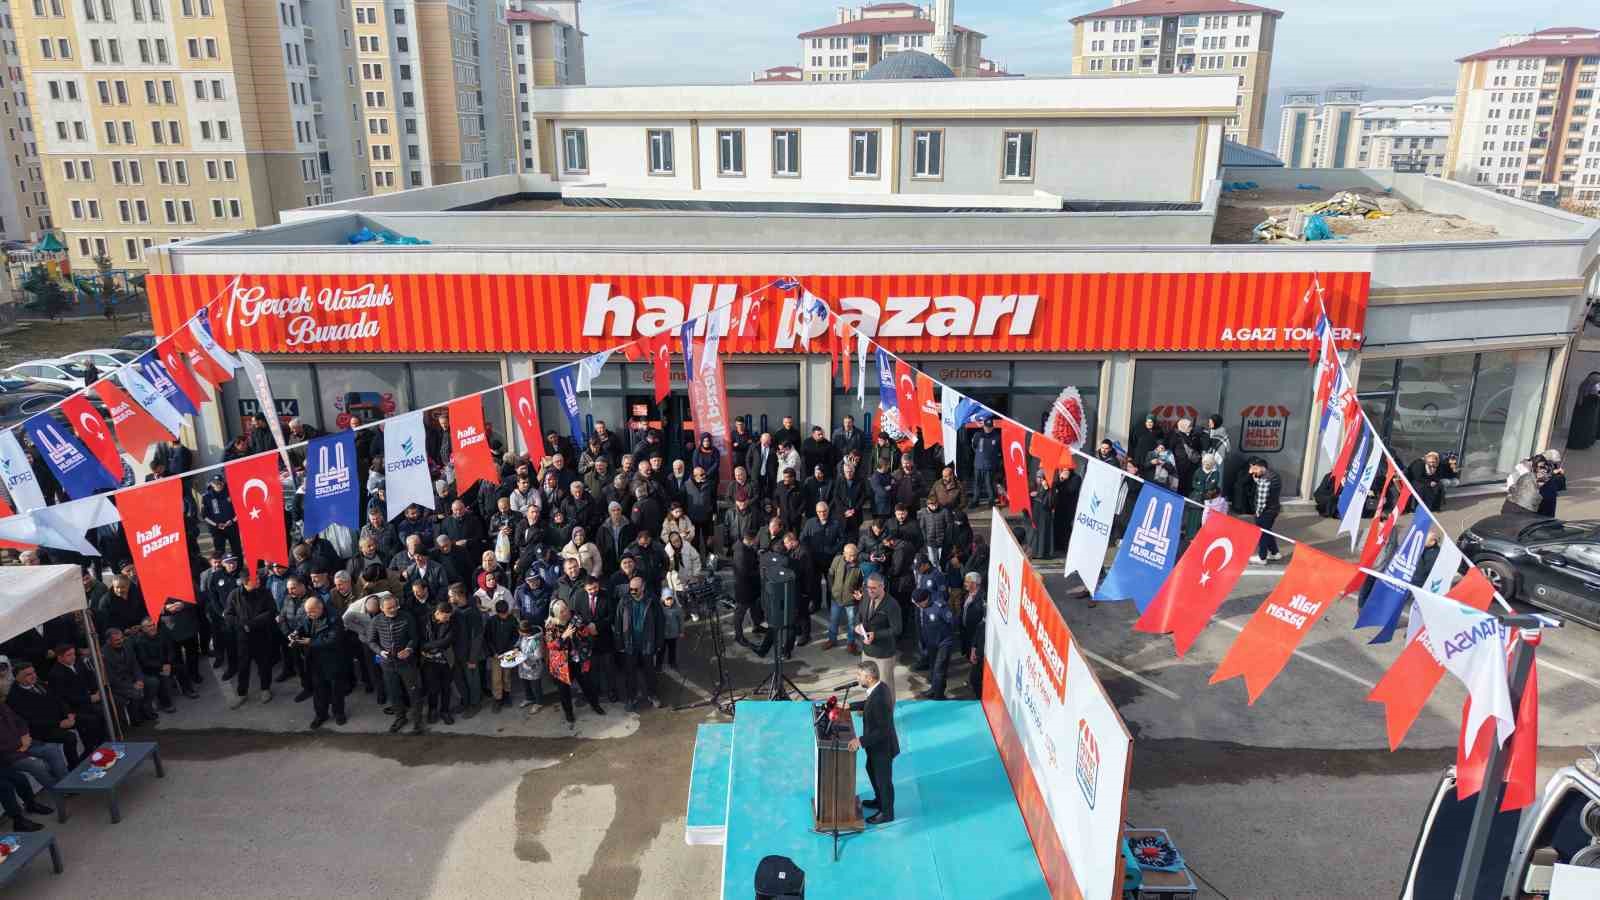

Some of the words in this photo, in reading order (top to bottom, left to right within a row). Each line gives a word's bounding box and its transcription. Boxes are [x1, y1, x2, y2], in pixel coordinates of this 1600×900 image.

[237, 286, 314, 327] Gerçek
[318, 283, 394, 312] Ucuzluk
[286, 312, 381, 346] Burada
[457, 425, 477, 438] halk
[1247, 419, 1282, 428] HALKIN
[387, 455, 426, 472] ERTANSA
[315, 481, 351, 496] ERZURUM
[136, 524, 162, 544] halk
[142, 532, 180, 558] pazarı
